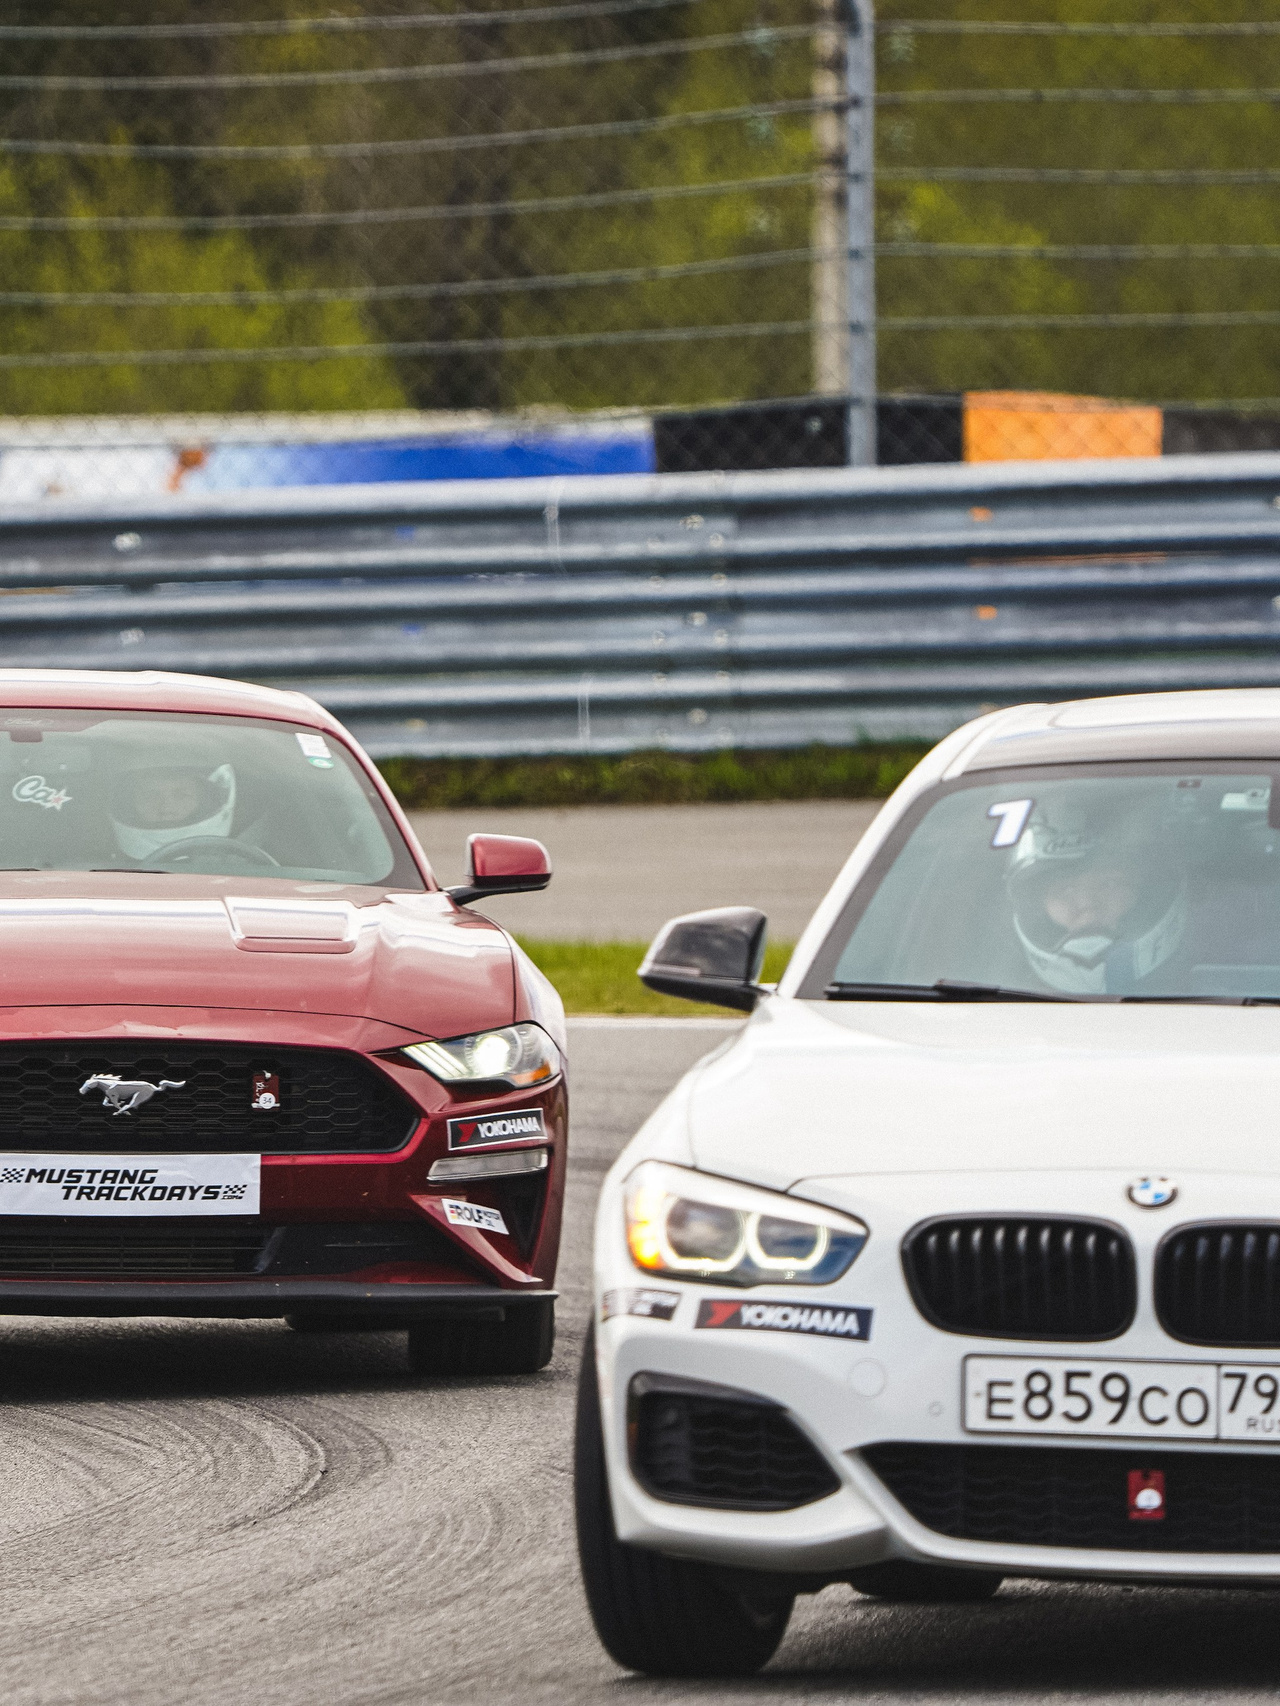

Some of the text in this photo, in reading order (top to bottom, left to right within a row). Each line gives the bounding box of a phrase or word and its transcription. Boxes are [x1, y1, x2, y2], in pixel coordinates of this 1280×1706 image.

[987, 799, 1033, 848] 1
[477, 1117, 541, 1138] YOKOHAMA
[25, 1168, 159, 1185] MUSTANG
[61, 1184, 222, 1202] TRACKDAYS
[740, 1303, 860, 1335] YOKOHAMA
